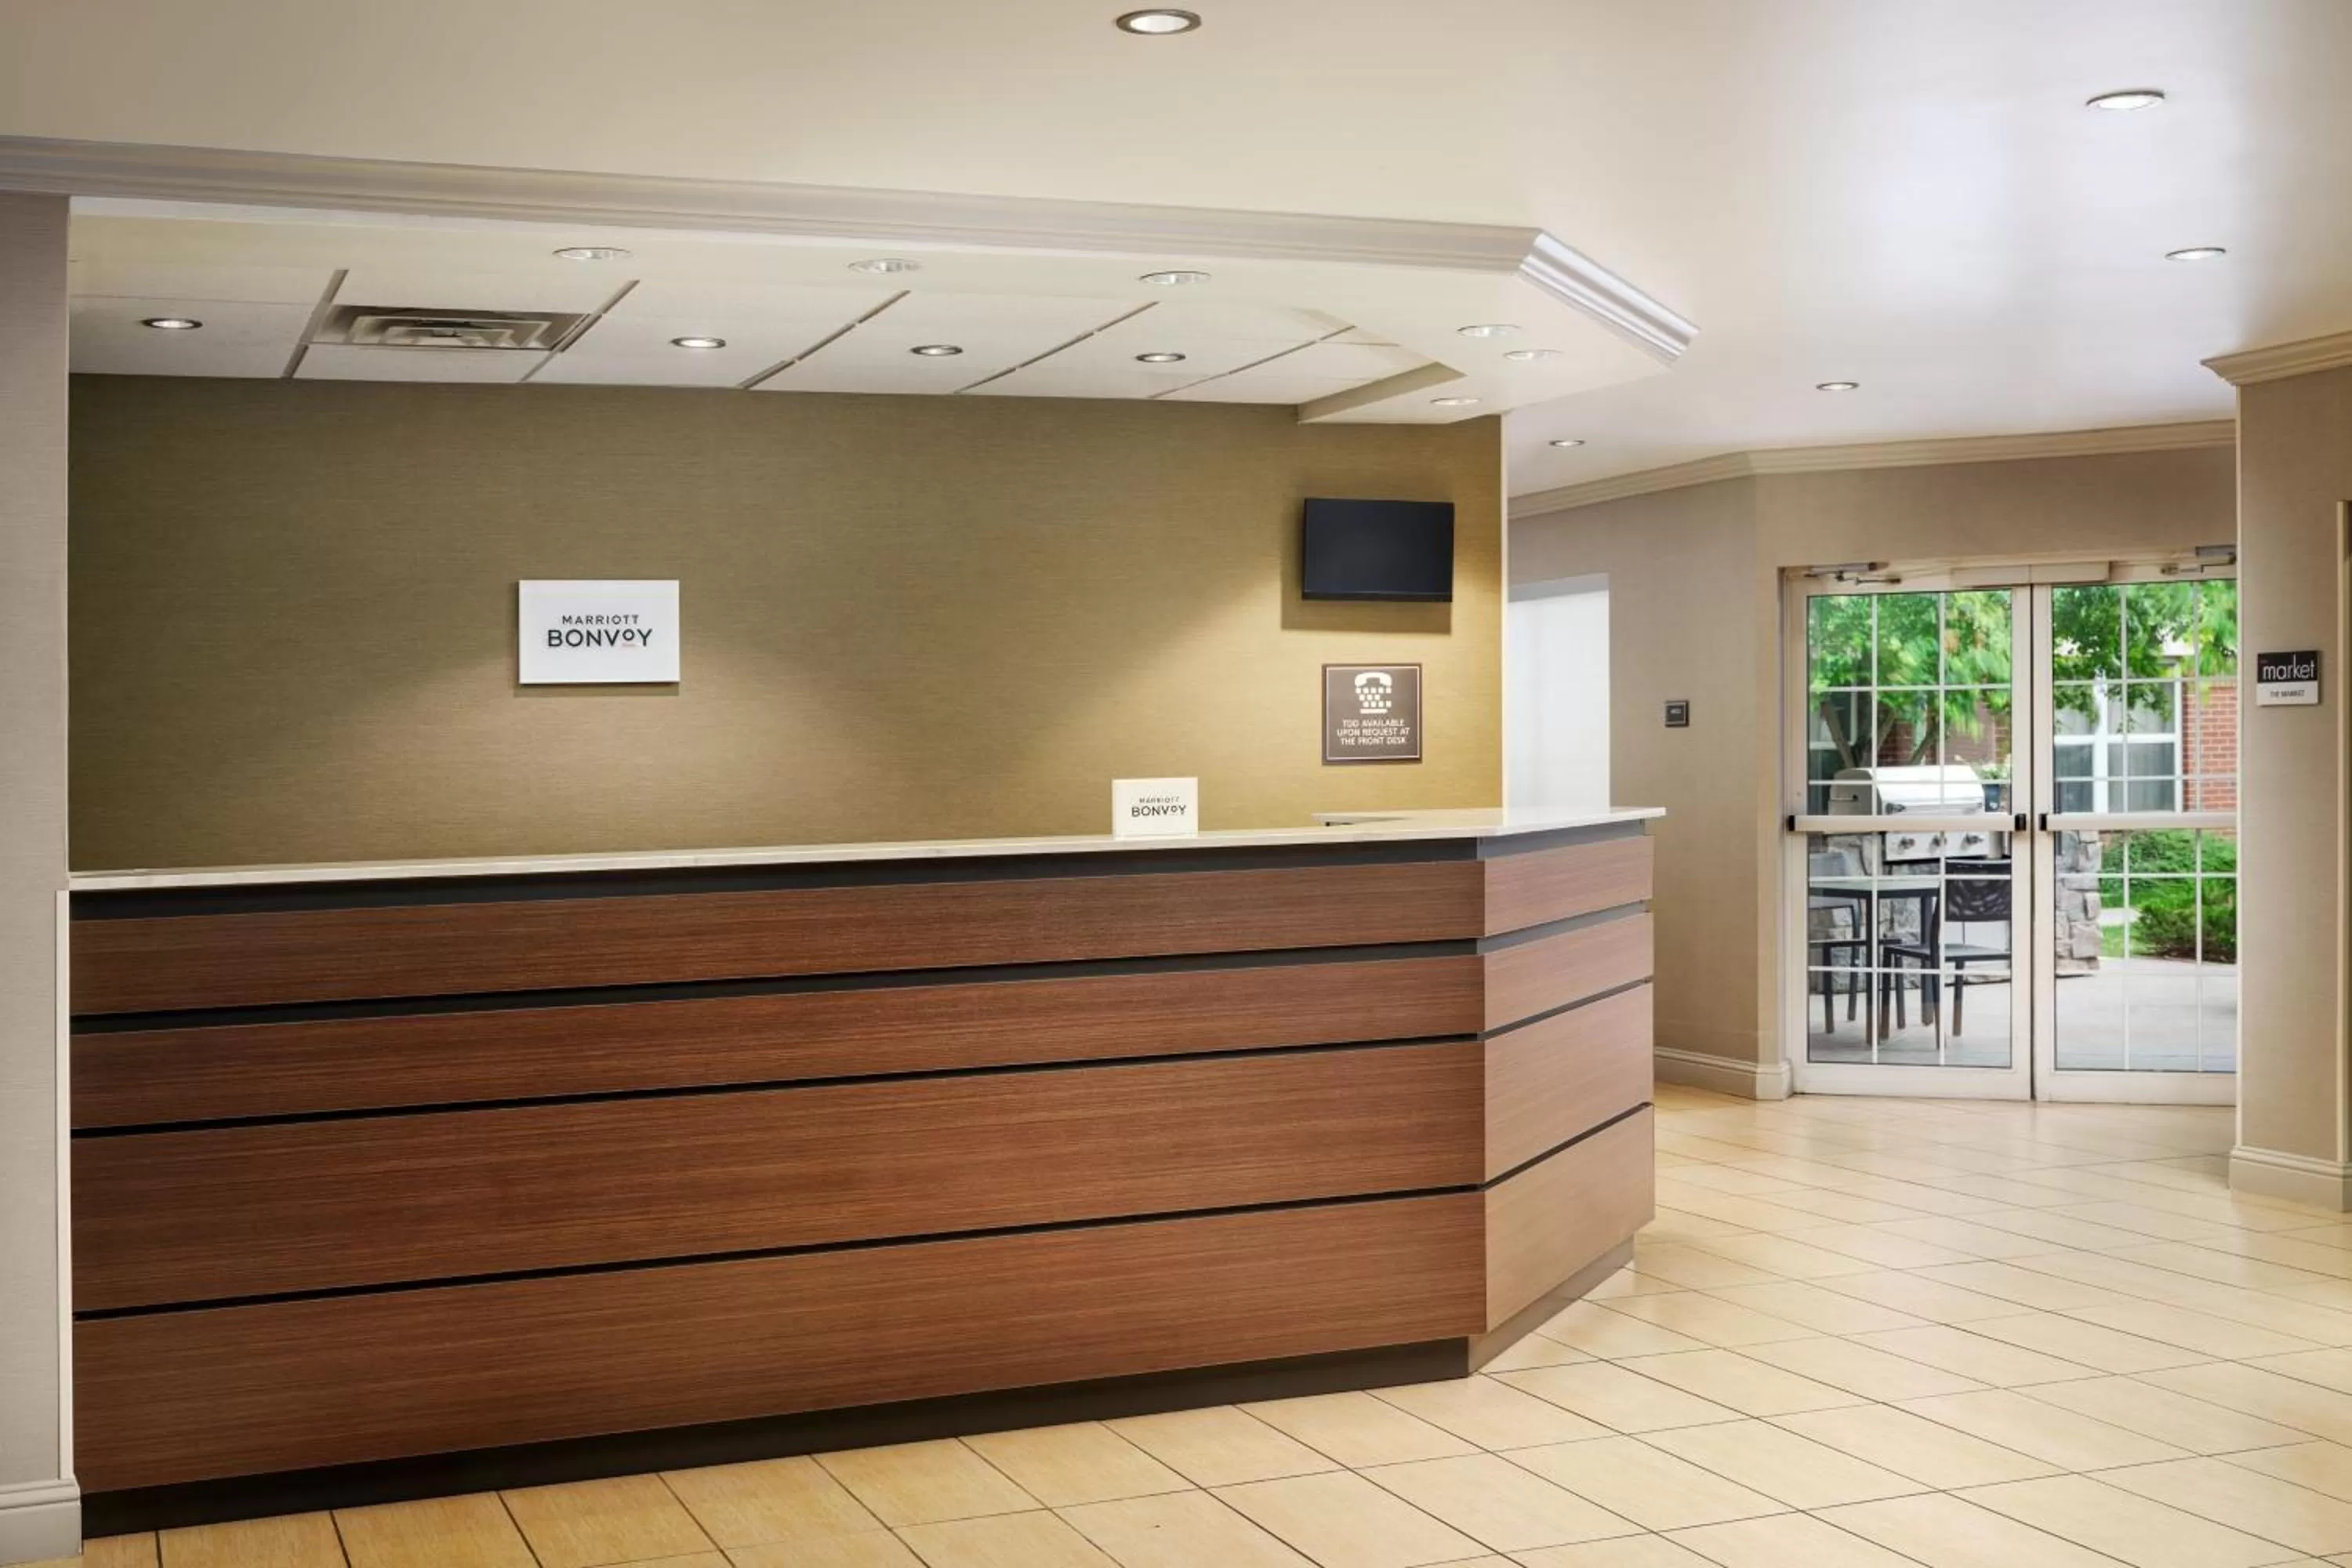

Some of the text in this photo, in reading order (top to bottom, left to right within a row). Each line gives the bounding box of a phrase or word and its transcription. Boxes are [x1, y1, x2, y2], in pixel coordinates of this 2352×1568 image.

[562, 615, 639, 625] MARRIOTT
[548, 629, 652, 647] BONVOY
[2263, 654, 2315, 680] market
[1337, 728, 1360, 737] UPON
[1362, 728, 1397, 736] REQUEST
[1387, 736, 1406, 745] DESK
[1131, 804, 1186, 817] BONVOY
